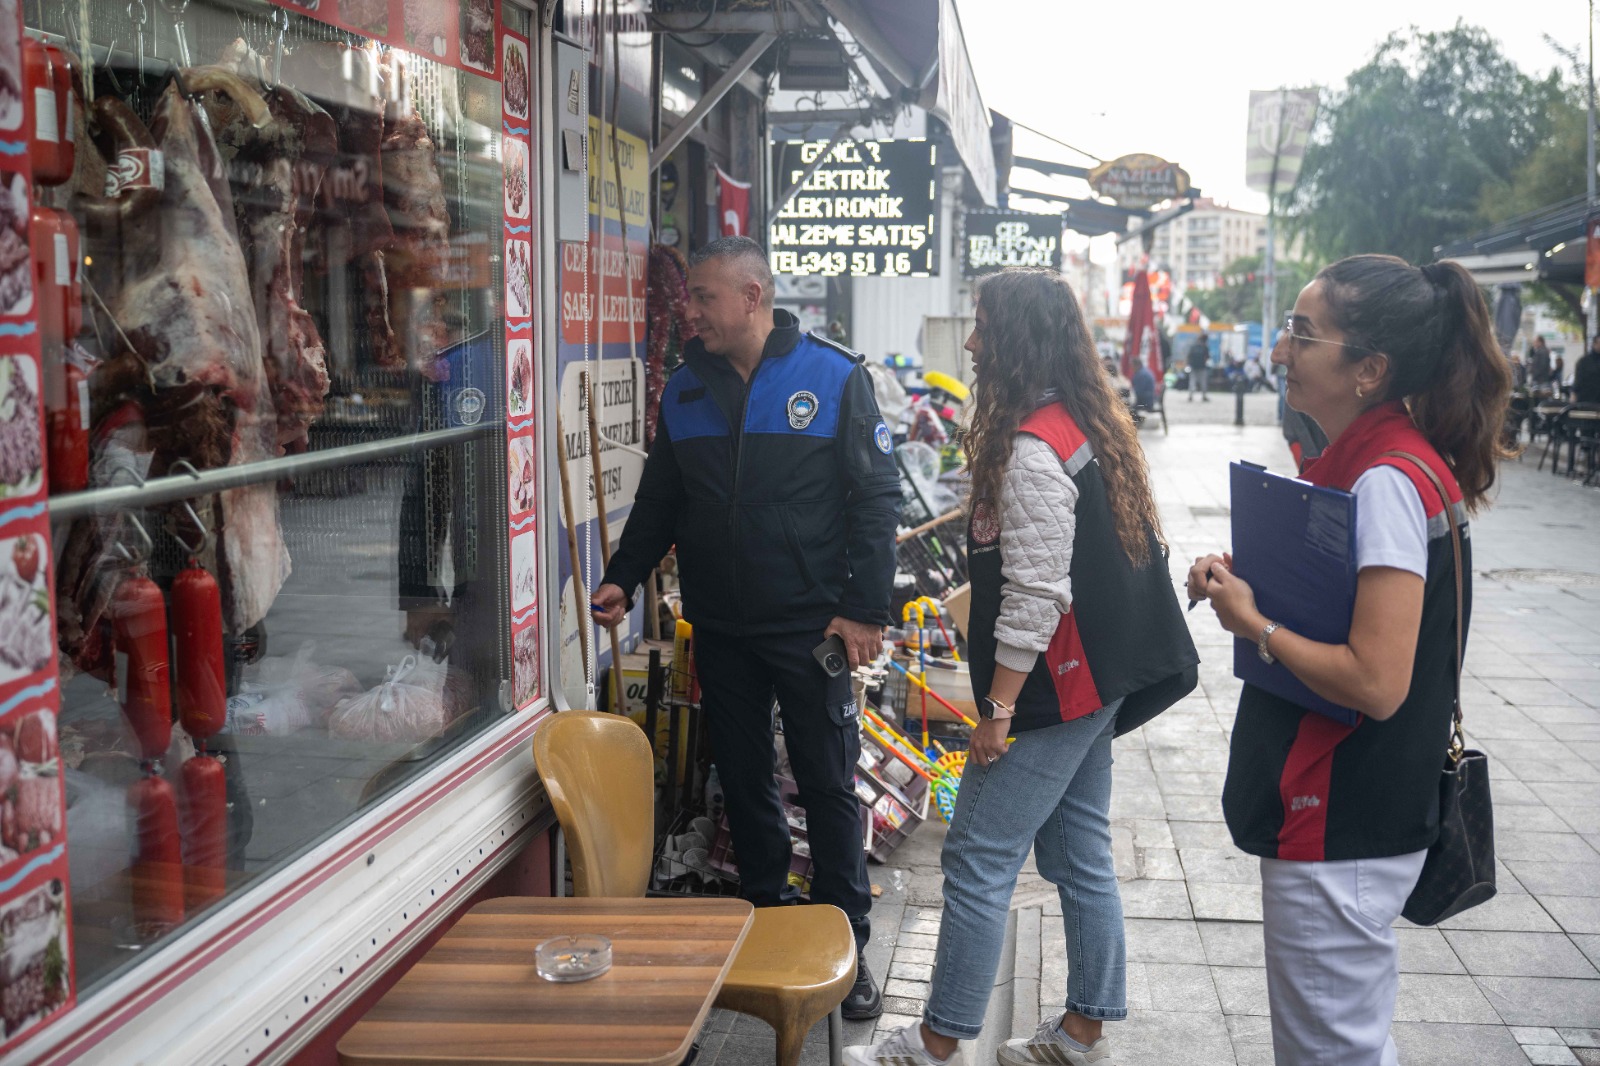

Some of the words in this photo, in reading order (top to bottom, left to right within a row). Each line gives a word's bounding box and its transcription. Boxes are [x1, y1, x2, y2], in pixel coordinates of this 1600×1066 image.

[858, 224, 926, 250] SATIŞ
[591, 246, 645, 281] TLEFNU
[851, 252, 876, 273] 51
[884, 252, 911, 273] 16
[579, 370, 633, 412] EKTRİK
[588, 466, 622, 501] STIŞI
